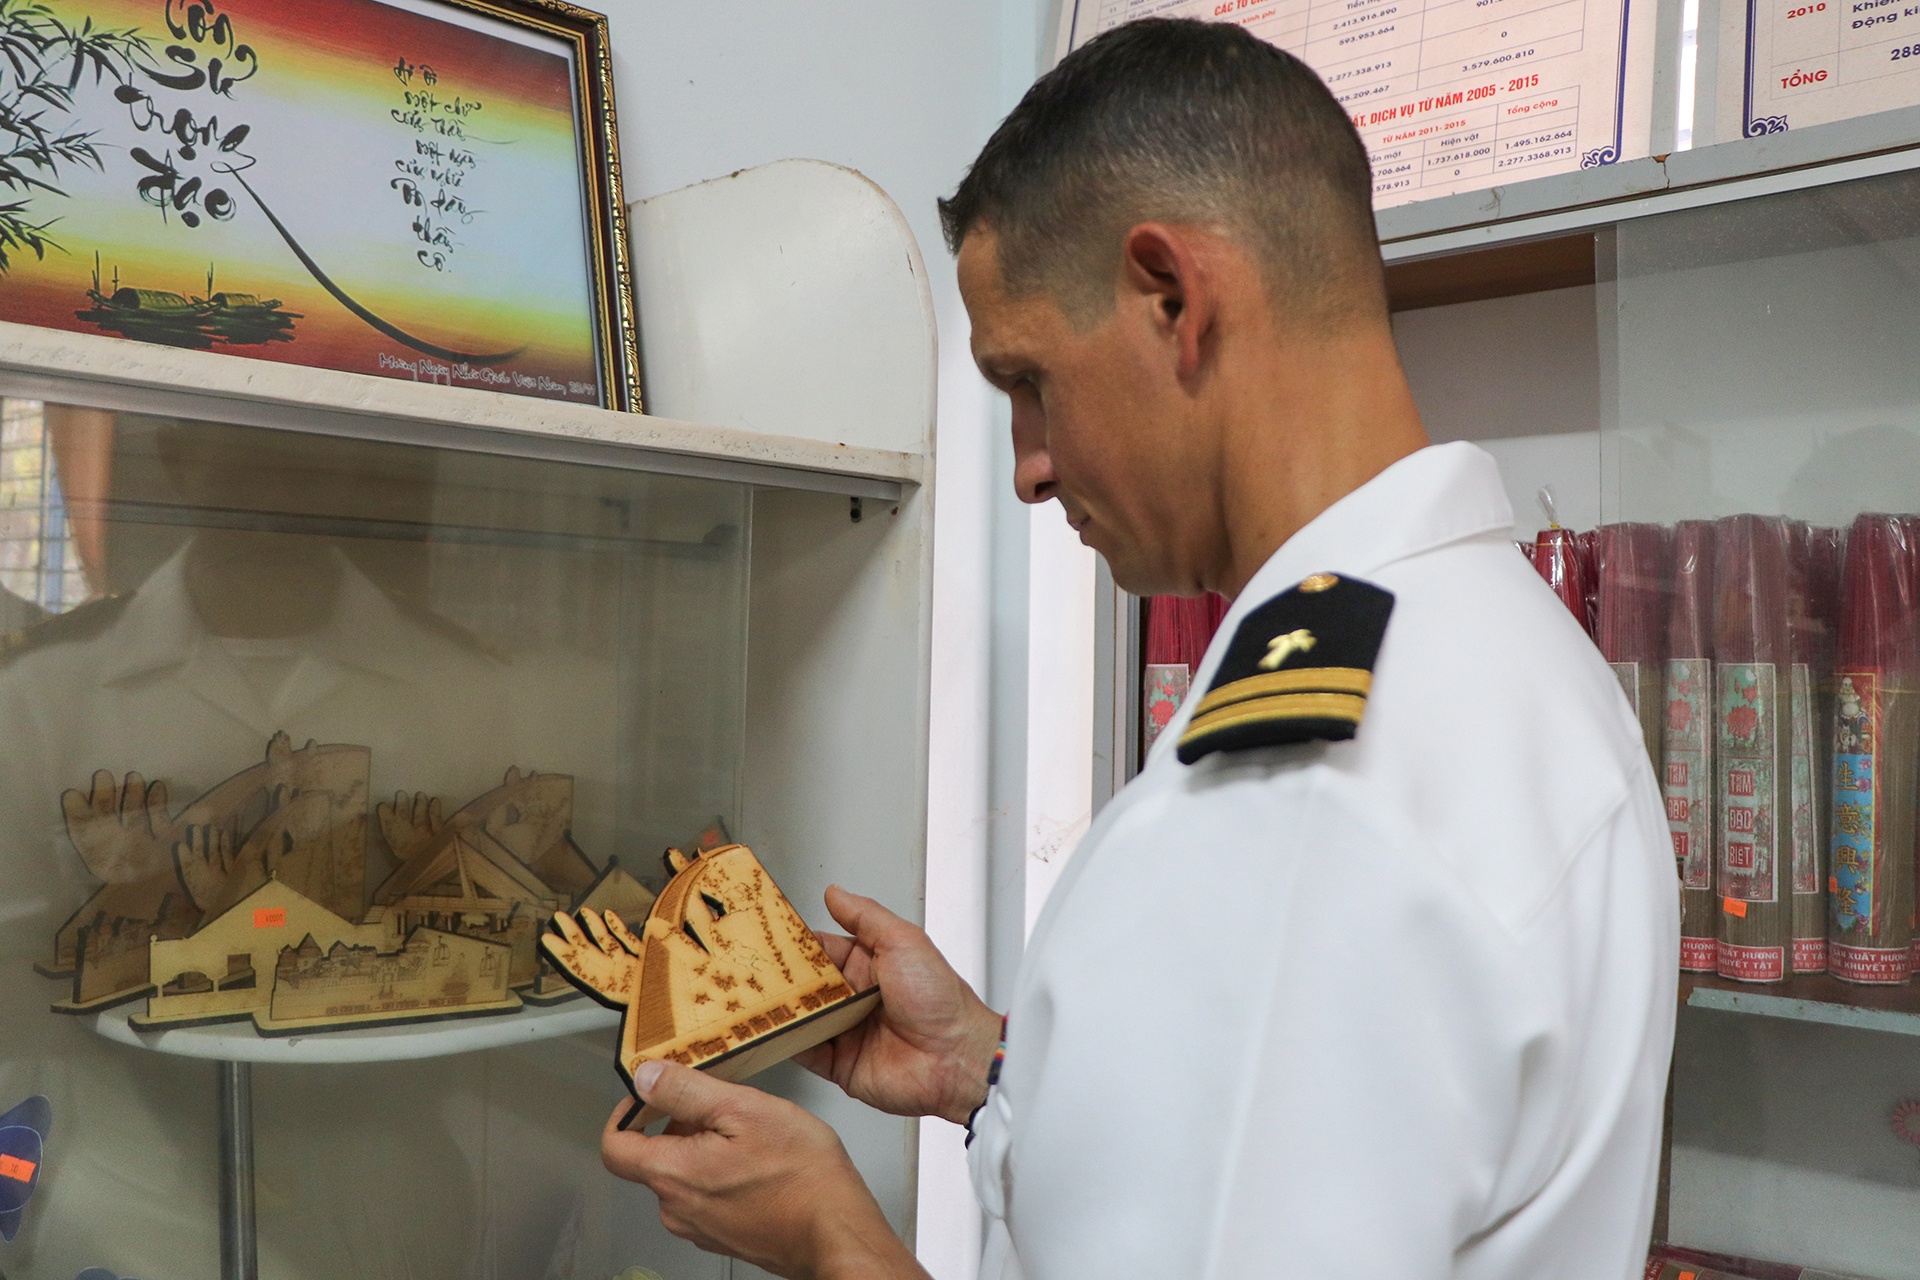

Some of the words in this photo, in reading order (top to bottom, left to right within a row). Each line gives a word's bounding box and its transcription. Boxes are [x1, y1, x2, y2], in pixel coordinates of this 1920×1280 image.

[1787, 2, 1827, 19] 2010
[1852, 13, 1897, 29] Động
[1904, 5, 1920, 17] ki
[1462, 49, 1535, 72] 3.579.600.810
[1781, 69, 1828, 89] TỔNG
[1370, 107, 1397, 125] DỊCH
[1400, 103, 1415, 118] VỤ
[1418, 97, 1433, 113] TỪ
[1435, 91, 1463, 109] NĂM
[1467, 84, 1496, 102] 2005
[1508, 74, 1539, 92] 2015
[1507, 103, 1530, 116] Tổng
[1533, 98, 1558, 110] cộng
[1395, 130, 1416, 141] NĂM
[1441, 136, 1461, 147] Hiện
[1464, 133, 1479, 143] vật
[1505, 130, 1572, 150] 1.495.162.664
[1427, 148, 1490, 166] 1.737.618.000
[1498, 146, 1572, 167] 2.277.3368.913
[1454, 168, 1460, 176] 0
